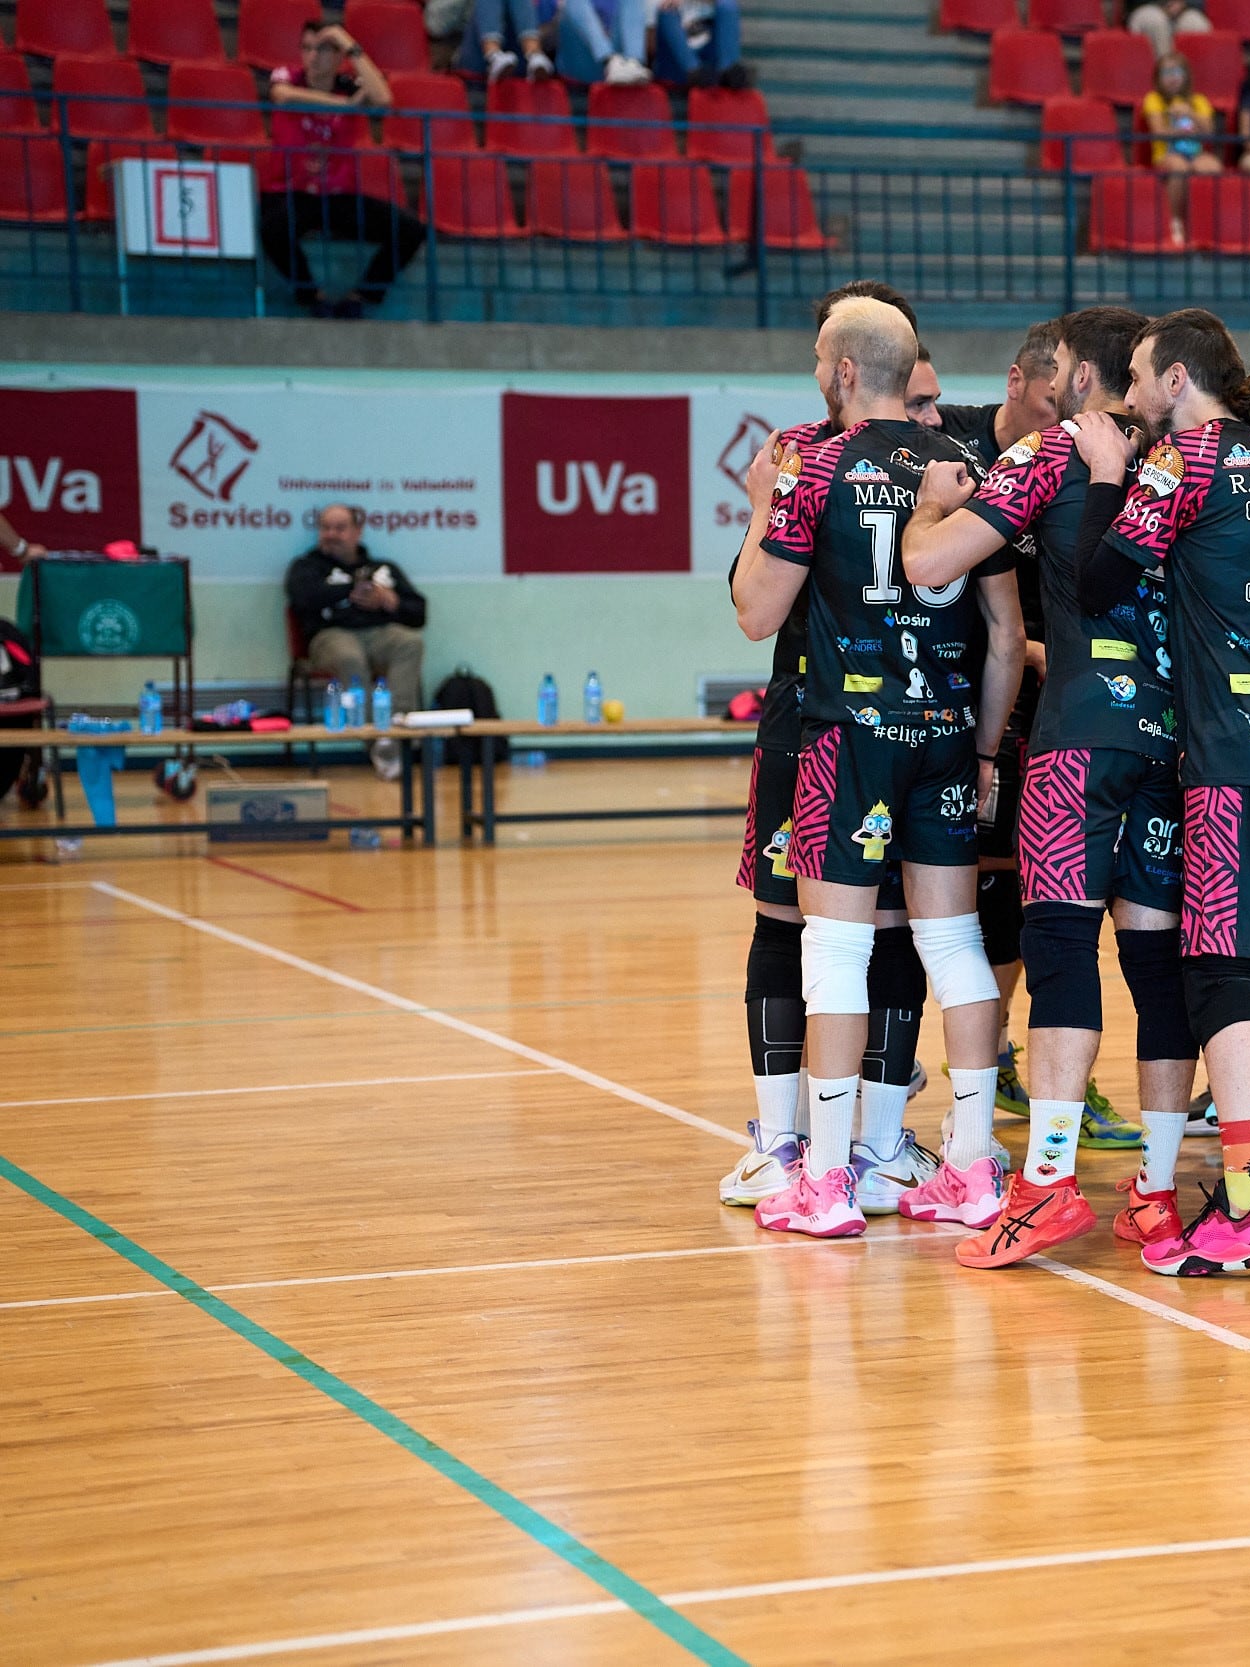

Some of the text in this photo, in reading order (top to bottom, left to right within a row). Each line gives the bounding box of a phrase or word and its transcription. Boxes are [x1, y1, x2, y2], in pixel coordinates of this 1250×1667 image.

[0, 456, 102, 513] Va
[536, 460, 658, 515] UVa
[980, 470, 1017, 496] S16
[1150, 470, 1175, 490] PISCINAS
[169, 502, 291, 529] Servicio
[924, 708, 954, 722] PMQ
[1138, 718, 1162, 737] Caja
[873, 724, 927, 748] #elige
